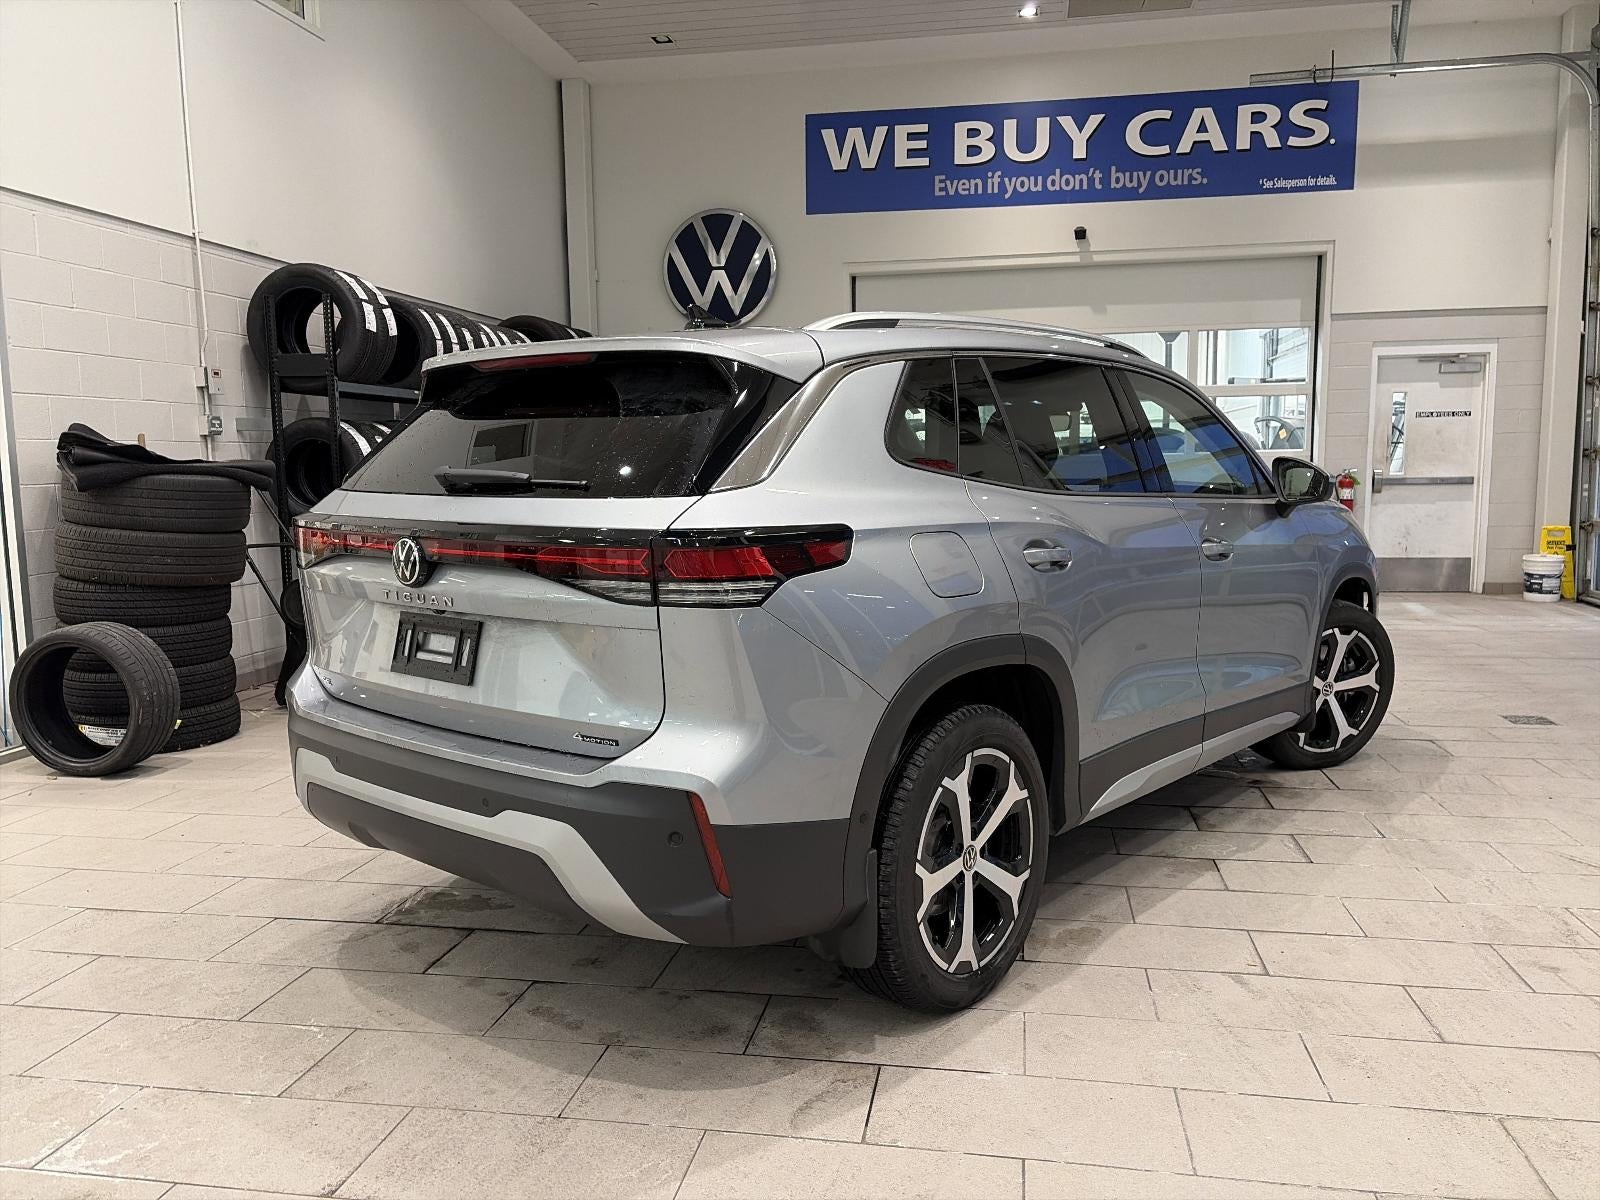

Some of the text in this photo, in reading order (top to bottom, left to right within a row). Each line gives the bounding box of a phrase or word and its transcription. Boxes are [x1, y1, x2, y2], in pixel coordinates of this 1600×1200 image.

[820, 123, 931, 171] WE
[953, 113, 1107, 166] BUY
[934, 165, 1208, 199] Even if you don't buy ours.
[1273, 177, 1307, 190] Salesperson
[1308, 175, 1317, 187] for
[1317, 174, 1337, 186] details.
[382, 589, 454, 607] TIGUAN
